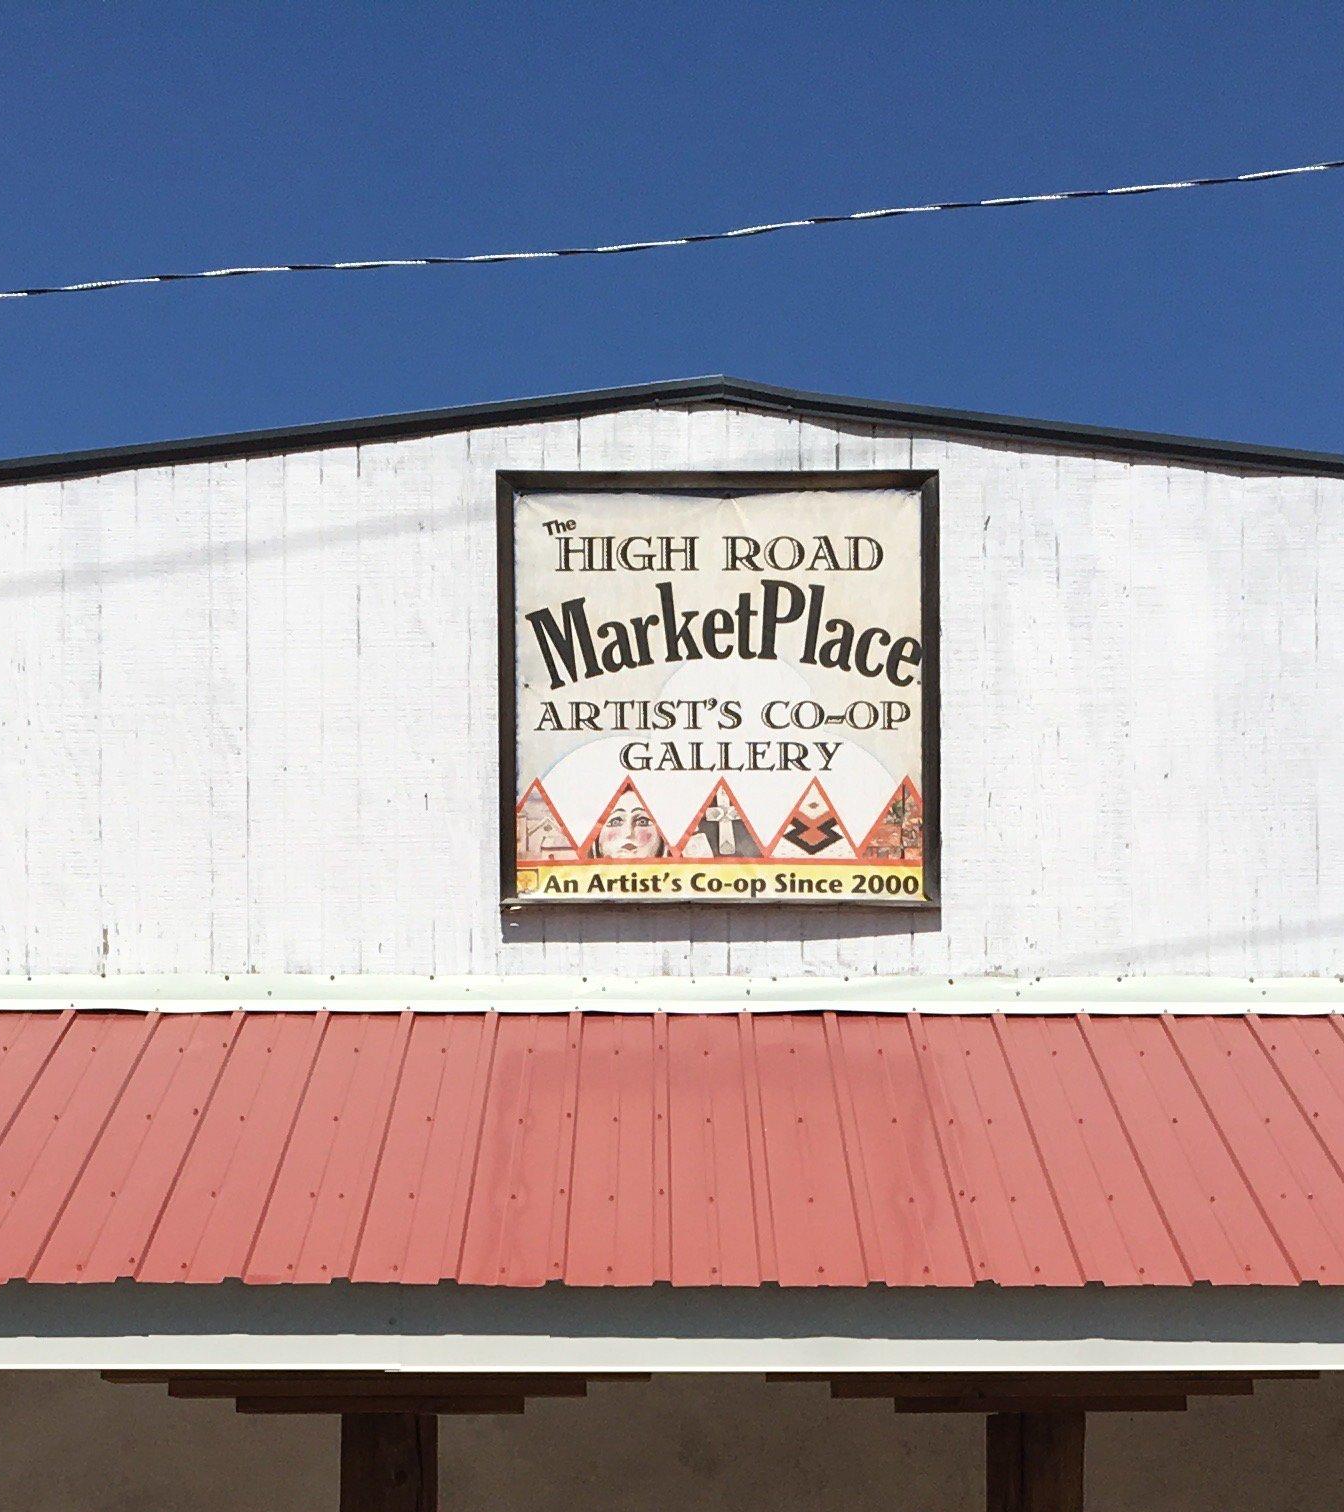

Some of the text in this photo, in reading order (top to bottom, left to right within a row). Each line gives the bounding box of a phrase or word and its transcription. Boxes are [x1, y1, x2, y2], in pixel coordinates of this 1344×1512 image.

[542, 516, 577, 537] The
[555, 535, 884, 572] HIGH ROAD
[525, 578, 922, 691] MarketPlace
[533, 697, 911, 732] ARTIST'S CO-OP
[618, 740, 843, 772] GALLERY
[543, 872, 919, 898] An Artist's Co-op Since 2000
